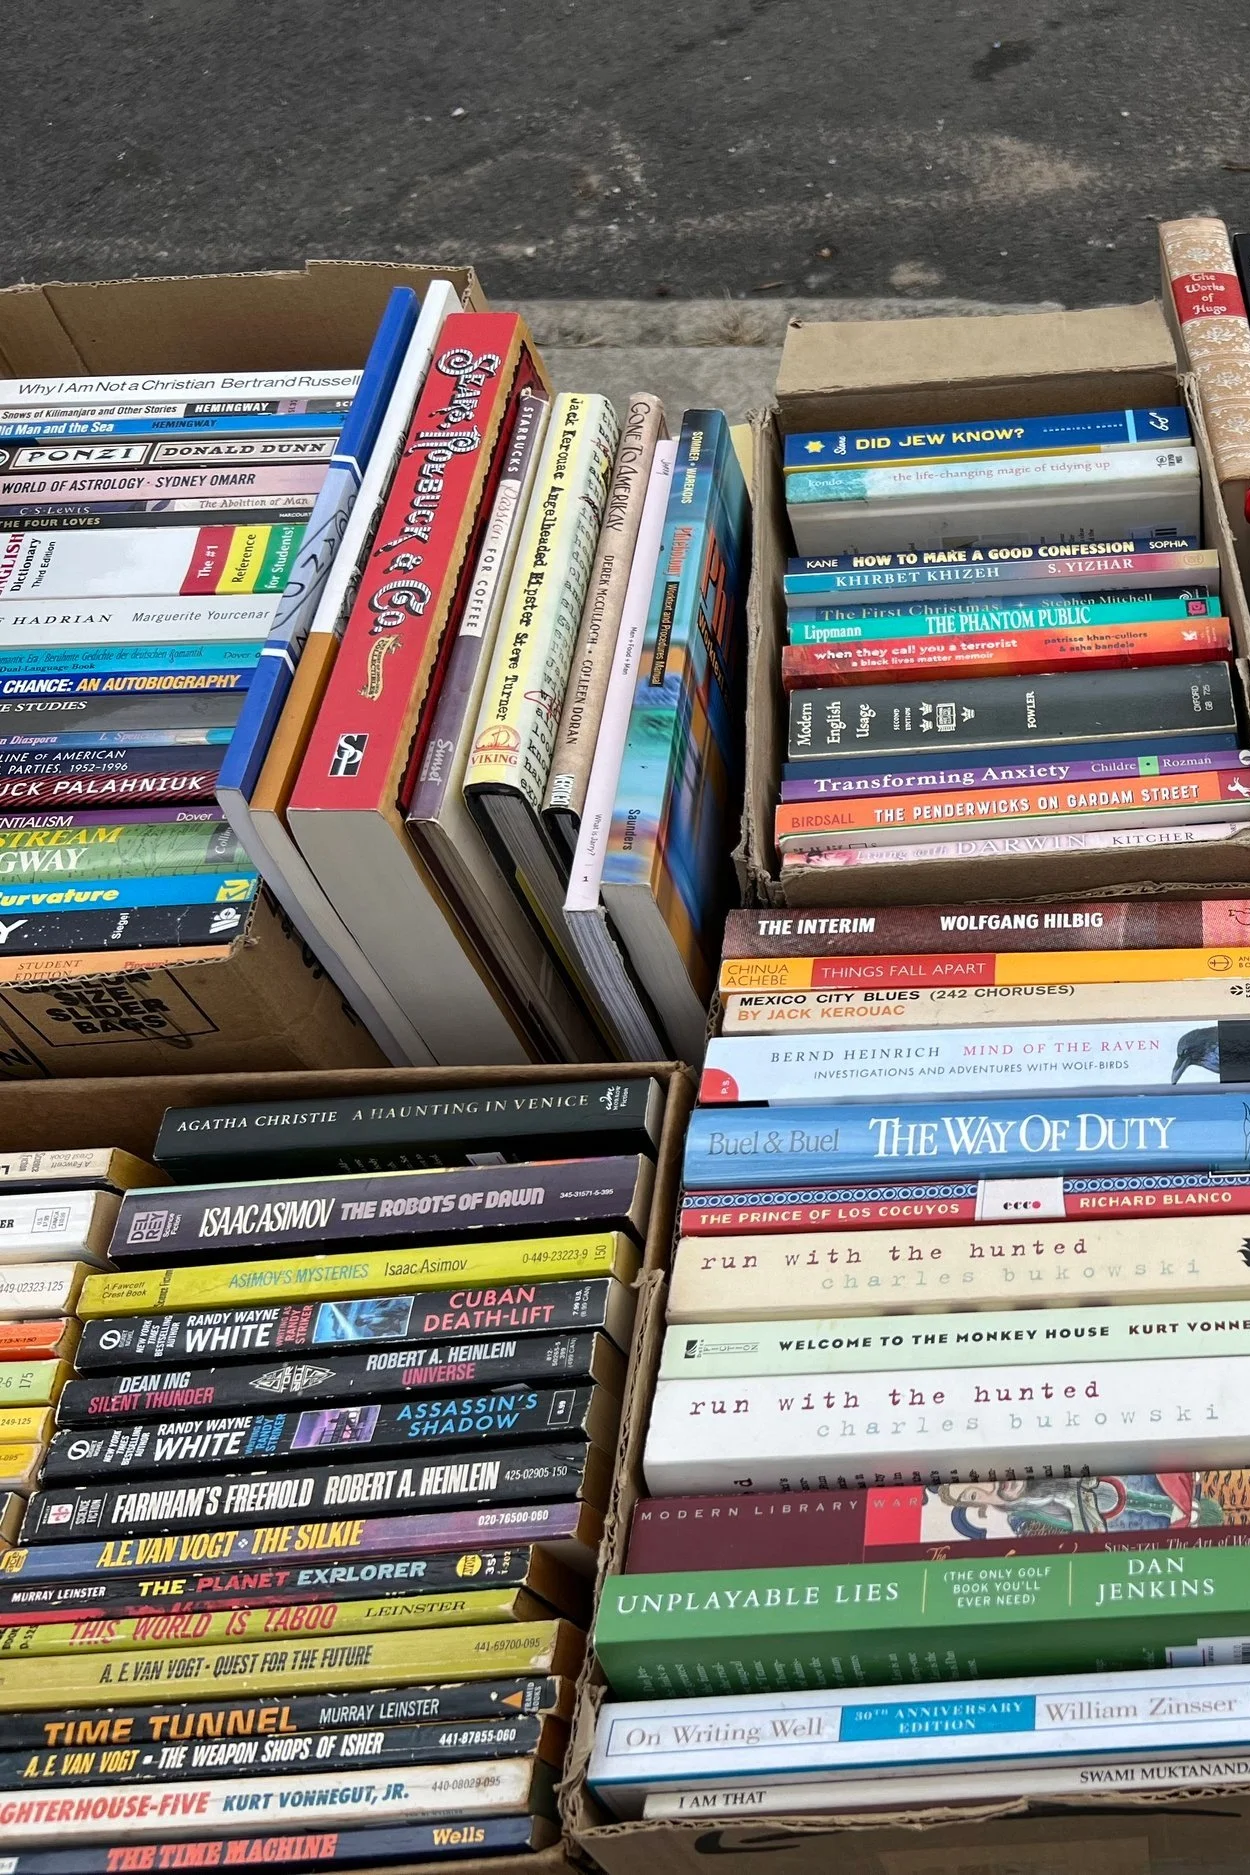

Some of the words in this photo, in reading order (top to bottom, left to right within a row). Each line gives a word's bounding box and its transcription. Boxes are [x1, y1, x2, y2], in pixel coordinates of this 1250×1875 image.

[1192, 302, 1227, 317] Hugo
[142, 378, 215, 391] Christian
[221, 377, 296, 389] Bertrand
[299, 374, 359, 388] Russell
[195, 402, 269, 413] HEMINGWAY
[508, 406, 533, 473] STARBUCKS
[856, 435, 891, 450] DID
[899, 431, 945, 447] JEW
[952, 426, 1025, 443] KNOW?
[28, 448, 132, 462] PONZI
[155, 476, 207, 488] SYDNEY
[210, 474, 256, 486] OMARR
[916, 467, 993, 483] life-changing
[997, 463, 1030, 479] magic
[1034, 461, 1047, 472] of
[1050, 460, 1091, 475] tidying
[1094, 461, 1110, 472] up
[466, 579, 487, 629] COFFEE
[132, 612, 201, 623] Marguerite
[208, 609, 270, 620] Yourcenar
[76, 679, 99, 692] AN
[102, 675, 241, 690] AUTOBIOGRAPHY
[1026, 691, 1037, 729] FOWLER
[797, 702, 812, 746] Modern
[471, 754, 518, 766] VIKING
[52, 776, 206, 795] PALAHNIUK
[814, 769, 975, 793] Transforming
[982, 764, 1071, 782] Anxiety
[624, 808, 640, 850] Saunders
[1112, 831, 1195, 846] KITCHER
[940, 914, 1039, 931] WOLFGANG
[1043, 912, 1103, 929] HILBIG
[18, 960, 82, 971] STUDENT
[822, 964, 884, 980] THINGS
[890, 963, 927, 976] FALL
[933, 961, 986, 976] APART
[72, 1018, 167, 1034] BAGS
[814, 1066, 916, 1080] INVESTIGATIONS
[921, 1066, 947, 1076] AND
[950, 1063, 1027, 1075] ADVENTURES
[1029, 1062, 1057, 1072] WITH
[1061, 1059, 1129, 1072] WOLF-BIRDS
[177, 1114, 250, 1133] AGATHA
[255, 1110, 337, 1127] CHRISTIE
[379, 1194, 454, 1218] ROBOTS
[459, 1192, 481, 1212] OF
[484, 1187, 545, 1208] DAWN
[522, 1248, 588, 1265] 0-449-23223-9
[384, 1260, 416, 1277] Isaac
[420, 1257, 467, 1275] Asimov
[424, 1305, 555, 1331] DEATH-LIFT
[402, 1363, 475, 1385] UNIVERSE
[223, 1478, 313, 1513] FREEHOLD
[617, 1587, 820, 1614] UNPLAYABLE
[835, 1582, 901, 1604] LIES
[365, 1601, 466, 1617] LEINSTER
[319, 1704, 376, 1725] MURRAY
[380, 1698, 440, 1719] LEINSTER
[1045, 1700, 1142, 1726] William
[1150, 1694, 1238, 1718] Zinsser
[44, 1717, 132, 1746] TIME
[148, 1706, 298, 1738] TUNNEL
[1080, 1766, 1136, 1784] SWAMI
[223, 1791, 275, 1813] KURT
[381, 1781, 410, 1801] JR.
[432, 1826, 484, 1846] Wells
